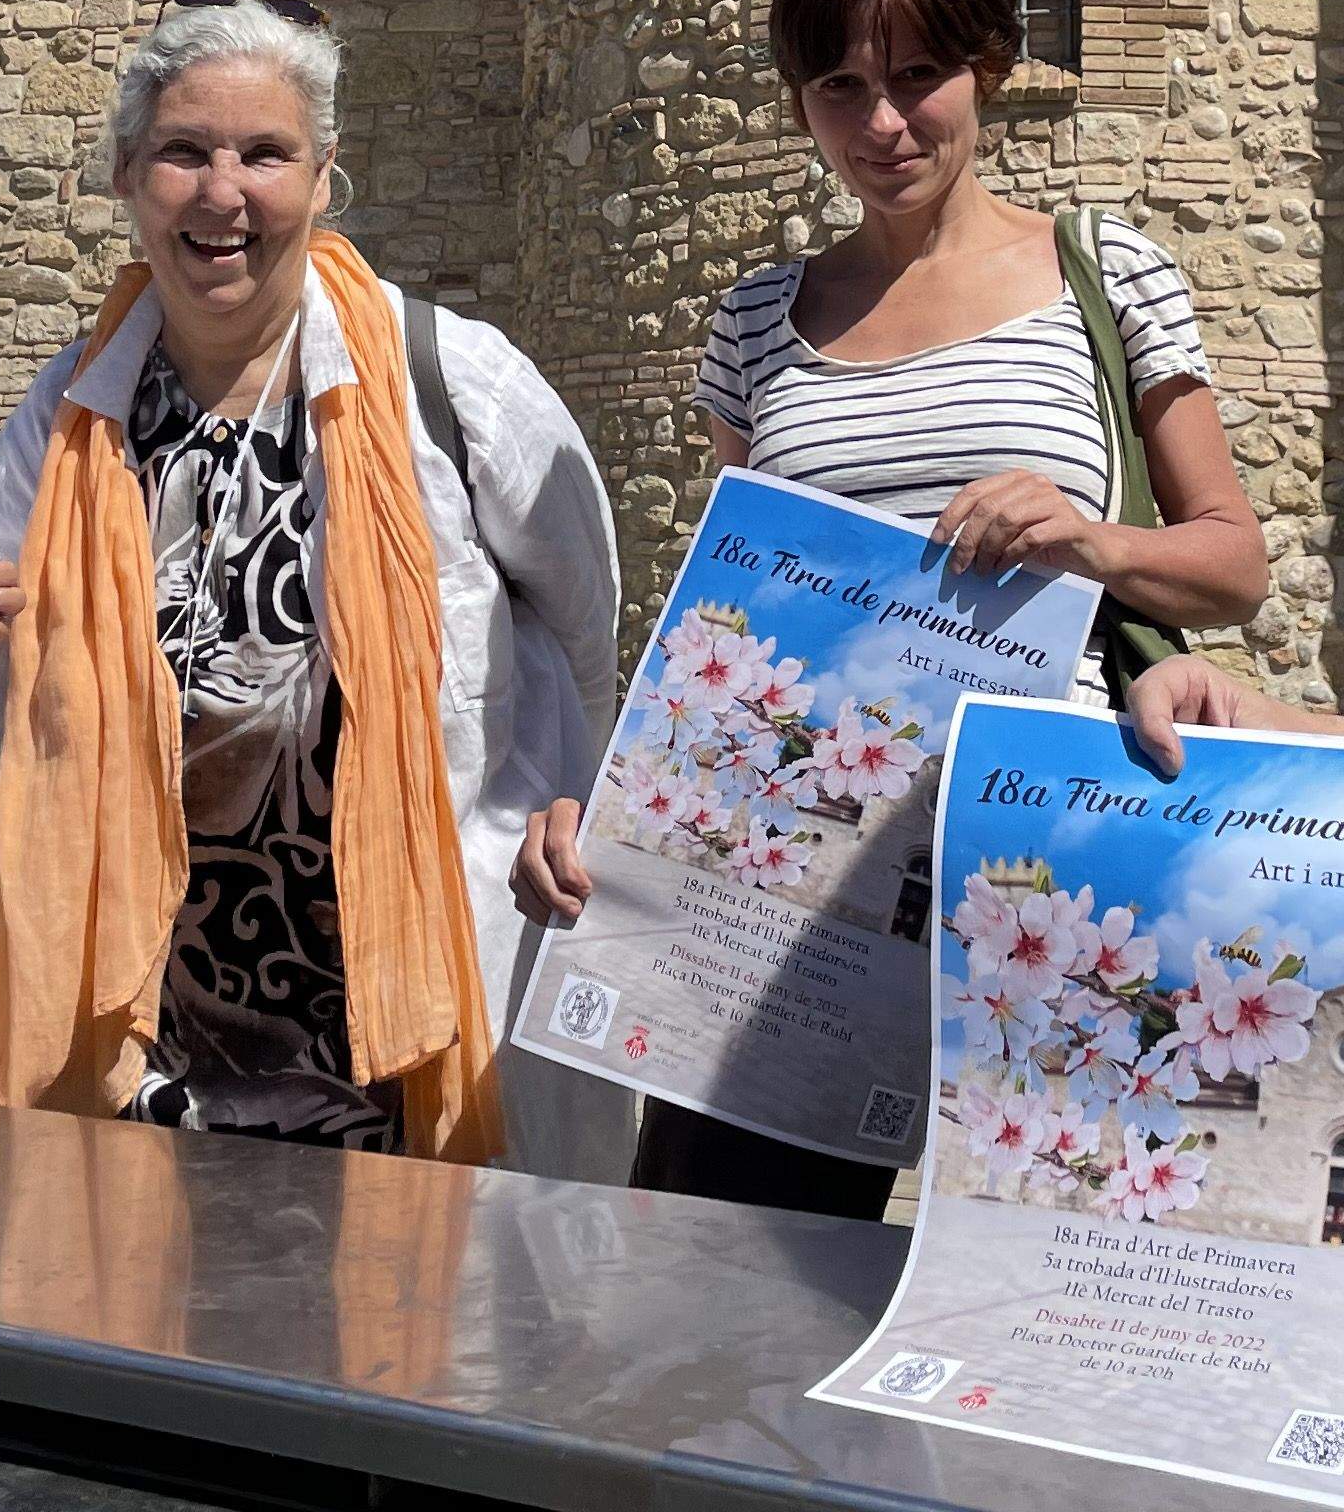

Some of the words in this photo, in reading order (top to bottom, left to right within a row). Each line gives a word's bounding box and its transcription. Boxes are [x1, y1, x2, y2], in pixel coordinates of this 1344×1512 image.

[709, 532, 762, 573] 18a
[772, 549, 835, 596] Fira
[841, 577, 882, 611] de
[879, 597, 1050, 670] primavera
[898, 646, 933, 671] Art
[936, 659, 944, 676] i
[977, 766, 1053, 807] 18a
[1066, 776, 1154, 817] Fira
[1163, 794, 1214, 826] de
[1249, 856, 1293, 883] Art
[1303, 861, 1313, 885] i
[673, 895, 689, 911] 5a
[693, 903, 746, 932] trobada
[683, 876, 704, 895] 18a
[708, 885, 736, 906] Fira
[780, 911, 796, 927] de
[800, 918, 869, 955] Primavera
[670, 943, 726, 974] Dissabte
[744, 971, 759, 986] de
[760, 978, 789, 1001] juny
[794, 989, 811, 1005] de
[813, 997, 848, 1019] 2022
[714, 931, 763, 959] Mercat
[767, 950, 789, 969] del
[793, 959, 838, 987] Trasto
[653, 959, 687, 983] Plaça
[690, 973, 735, 1000] Doctor
[800, 1014, 817, 1030] de
[710, 1001, 726, 1017] de
[746, 1018, 753, 1027] a
[757, 1019, 781, 1038] 20h
[1042, 1251, 1061, 1270] 5a
[1067, 1257, 1134, 1280] trobada
[1054, 1225, 1080, 1245] 18a
[1085, 1229, 1120, 1252] Fira
[1125, 1235, 1173, 1258] d'Art
[1177, 1242, 1199, 1262] de
[1202, 1246, 1295, 1276] Primavera
[1092, 1284, 1155, 1308] Mercat
[1160, 1294, 1190, 1312] del
[1194, 1298, 1254, 1321] Trasto
[1010, 1327, 1053, 1346] Plaça
[1056, 1333, 1117, 1353] Doctor
[1120, 1341, 1198, 1364] Guardiet
[1201, 1351, 1223, 1368] de
[1226, 1355, 1273, 1375] Rubí
[1035, 1308, 1106, 1330] Dissabte
[1128, 1318, 1150, 1336] de
[1153, 1326, 1191, 1344] juny
[1195, 1330, 1217, 1346] de
[1221, 1333, 1266, 1352] 2022
[1079, 1356, 1101, 1370] de
[1105, 1359, 1124, 1373] 10
[1126, 1364, 1137, 1375] a
[1140, 1365, 1175, 1381] 20h
